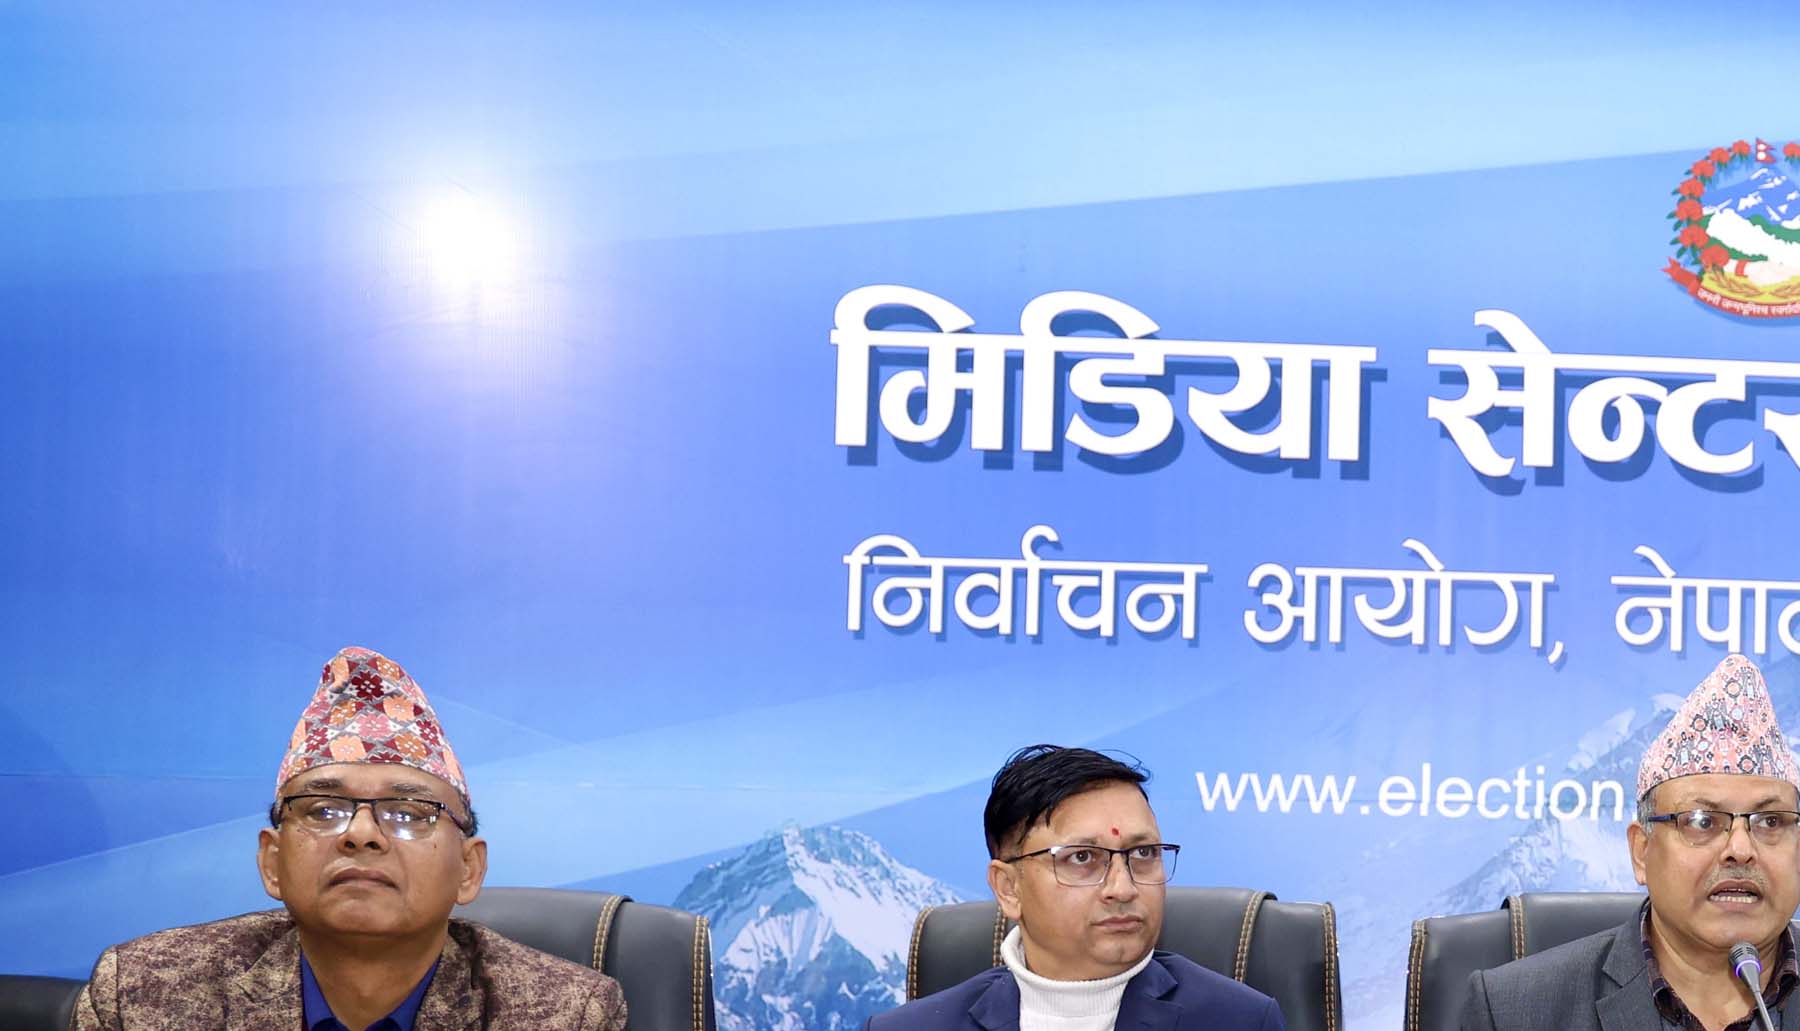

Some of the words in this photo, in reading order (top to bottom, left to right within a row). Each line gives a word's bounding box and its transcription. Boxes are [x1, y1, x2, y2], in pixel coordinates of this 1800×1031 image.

[830, 285, 1377, 460] मिडिया
[843, 525, 1208, 639] निर्वाचन
[1244, 539, 1564, 664] आयोग,
